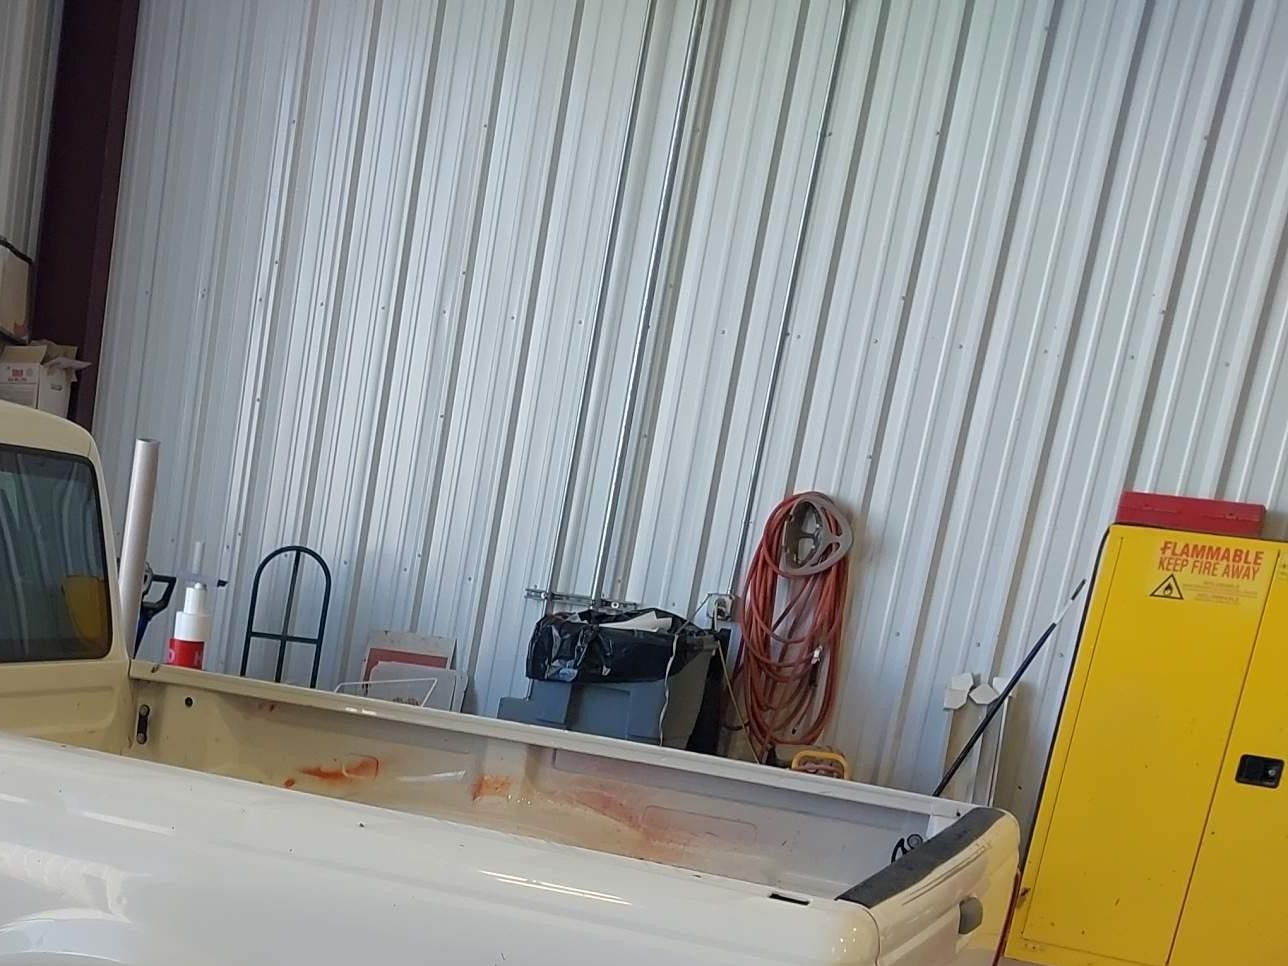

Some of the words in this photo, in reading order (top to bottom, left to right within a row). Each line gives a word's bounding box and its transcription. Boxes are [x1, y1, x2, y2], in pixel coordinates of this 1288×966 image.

[1160, 541, 1264, 566] FLAMMABLE
[1158, 557, 1189, 573] KEEP
[1191, 560, 1221, 577] FIRE
[1222, 563, 1260, 581] AWAY
